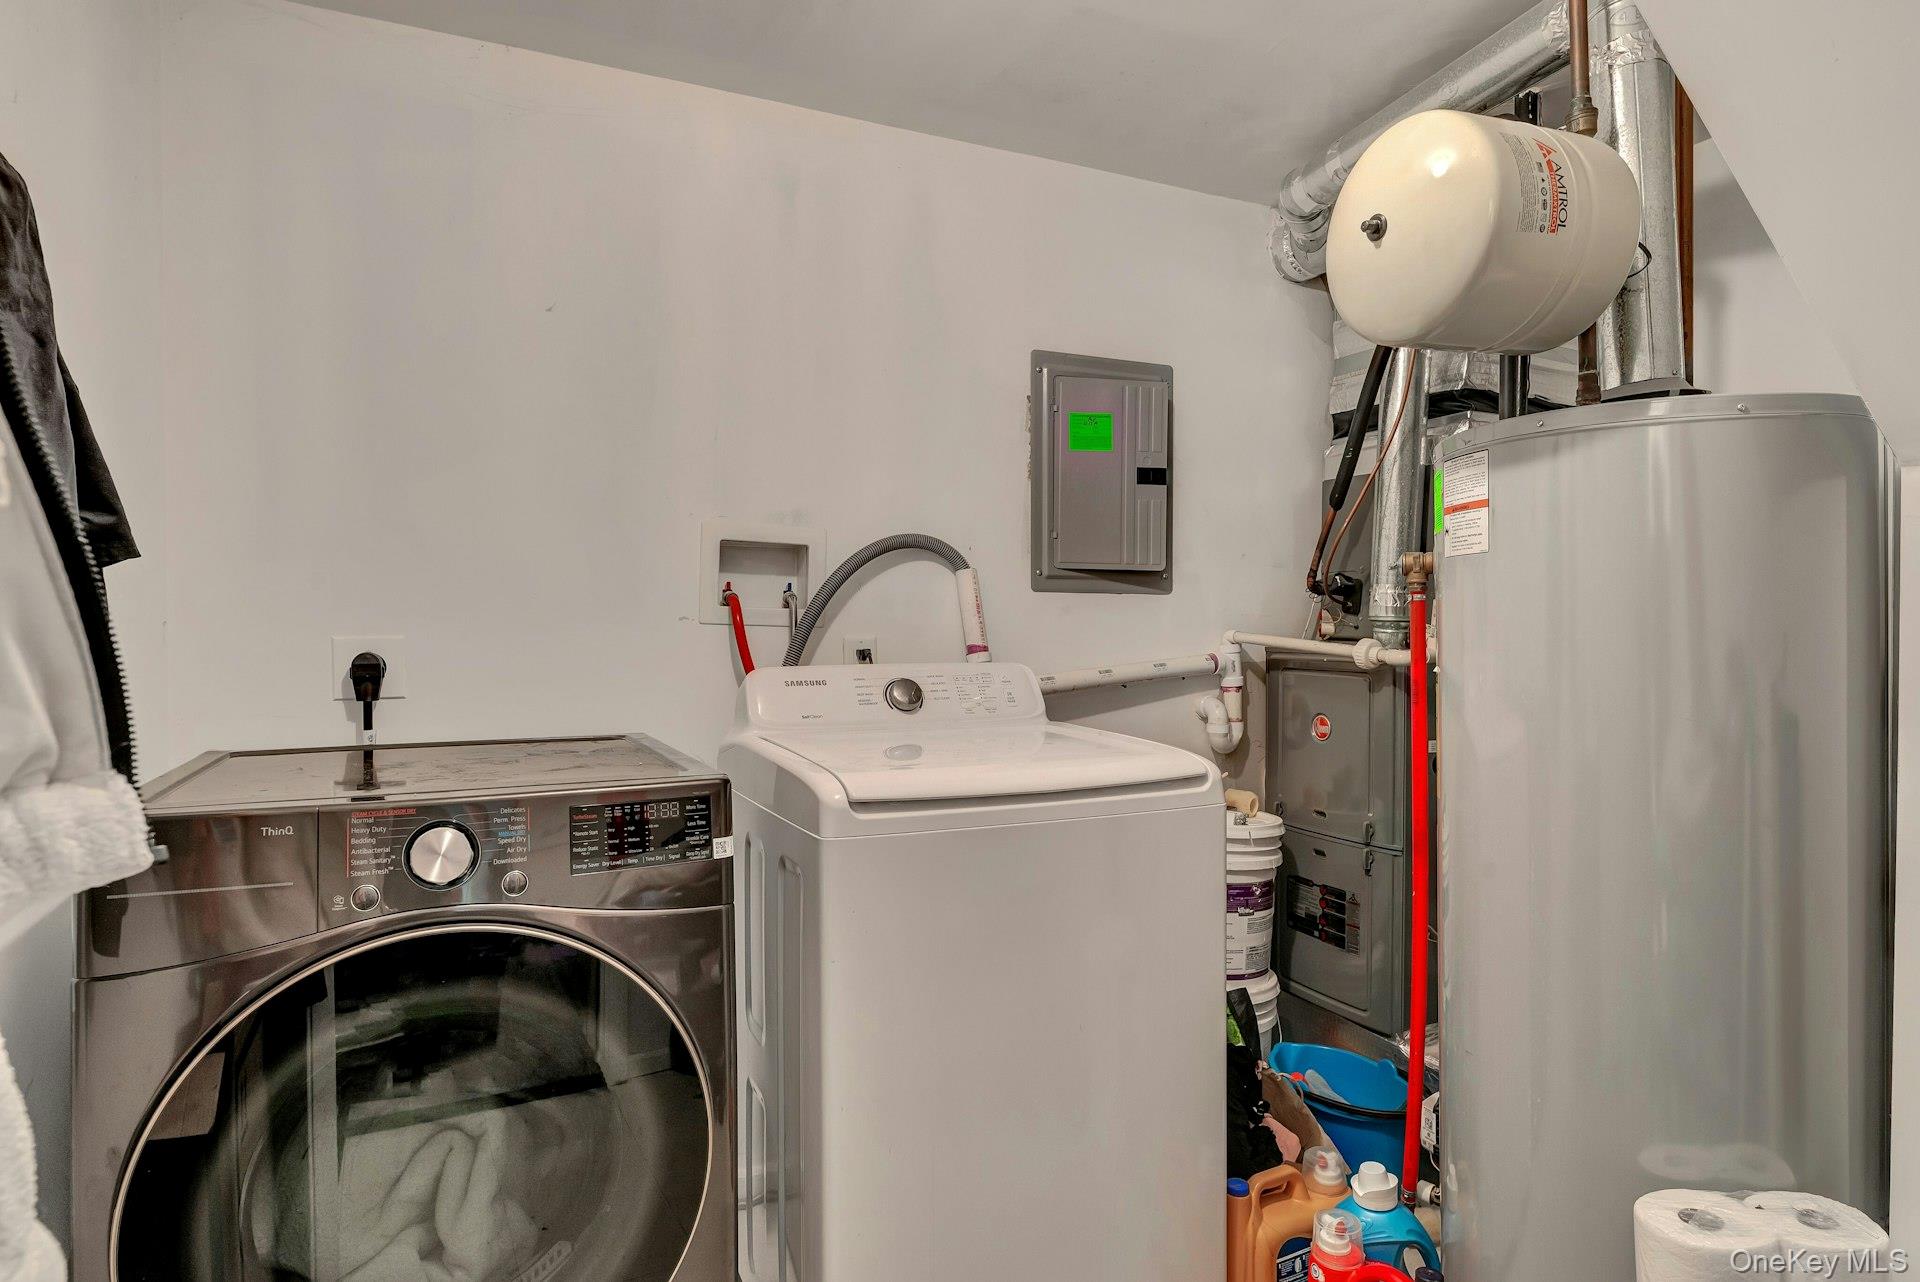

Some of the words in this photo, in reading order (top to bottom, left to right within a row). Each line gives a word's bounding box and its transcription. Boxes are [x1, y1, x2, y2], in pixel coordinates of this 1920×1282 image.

[1550, 159, 1568, 228] AMTROL
[260, 825, 294, 836] ThinQ
[351, 837, 376, 845] Bedding
[497, 837, 515, 845] Speed
[351, 846, 391, 855] Antibacterial
[351, 858, 368, 866] Steam
[493, 856, 528, 865] Downloaded
[350, 869, 371, 877] Steam
